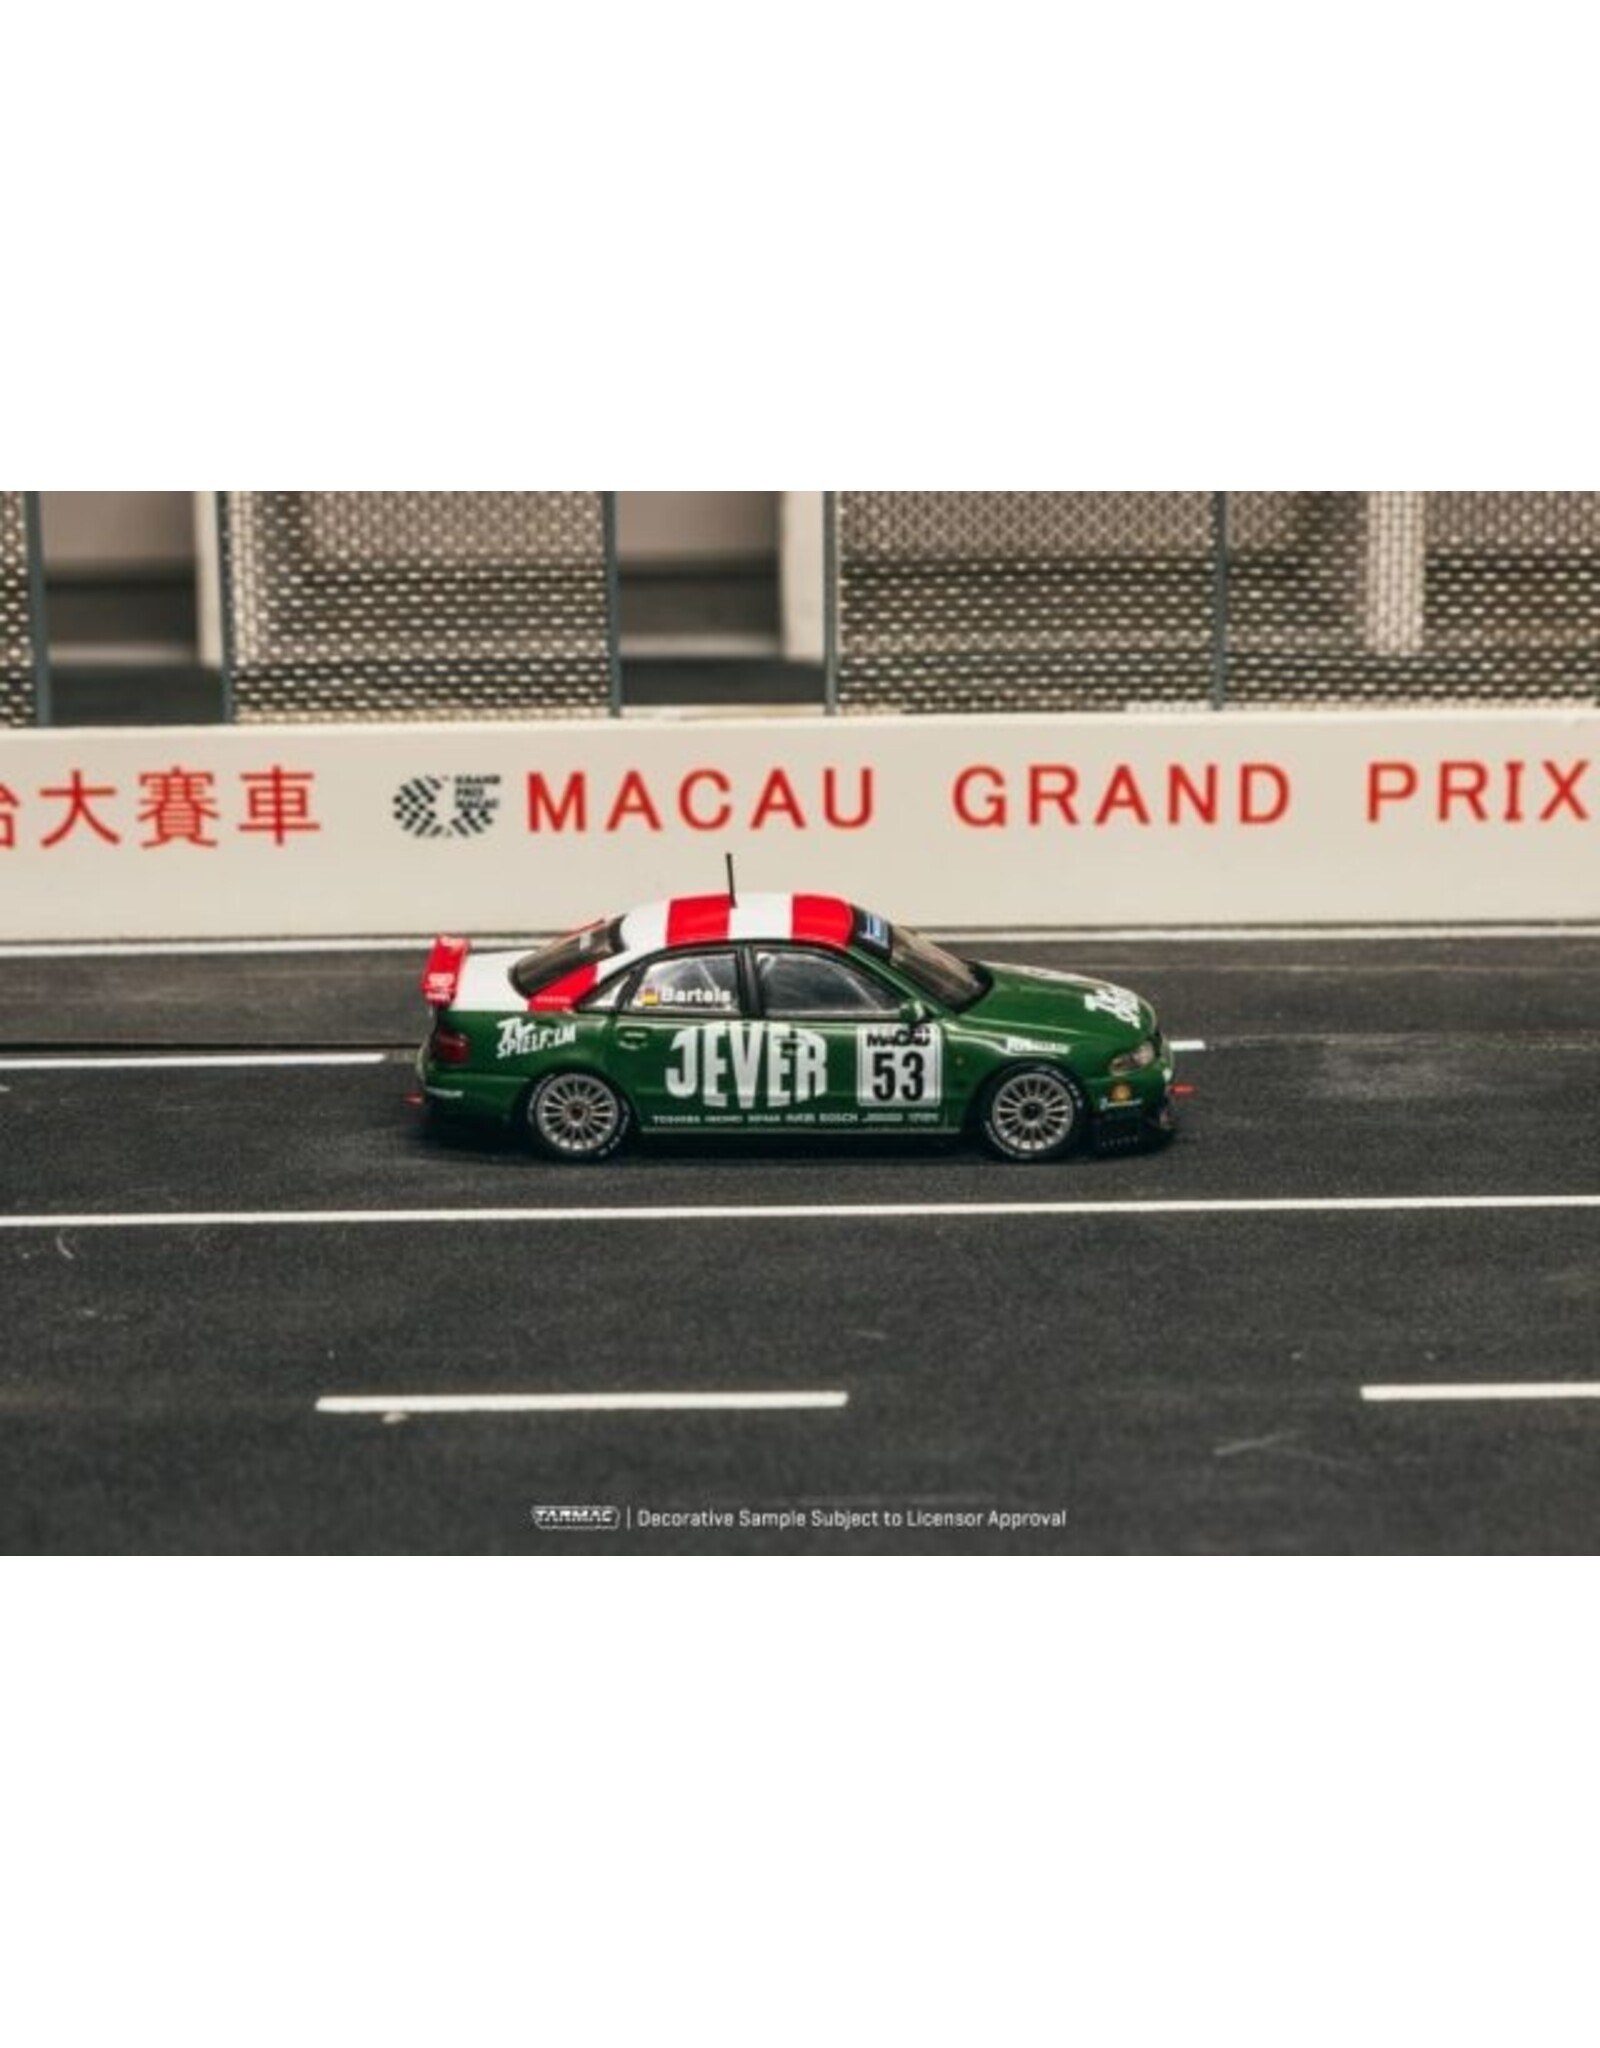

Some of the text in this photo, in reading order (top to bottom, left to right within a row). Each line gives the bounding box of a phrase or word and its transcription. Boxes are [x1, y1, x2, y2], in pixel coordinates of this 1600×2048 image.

[526, 760, 1589, 832] MACAU GRAND PRIX
[661, 986, 732, 1004] Bartels
[664, 1020, 829, 1109] JEVER
[873, 1051, 924, 1102] 53
